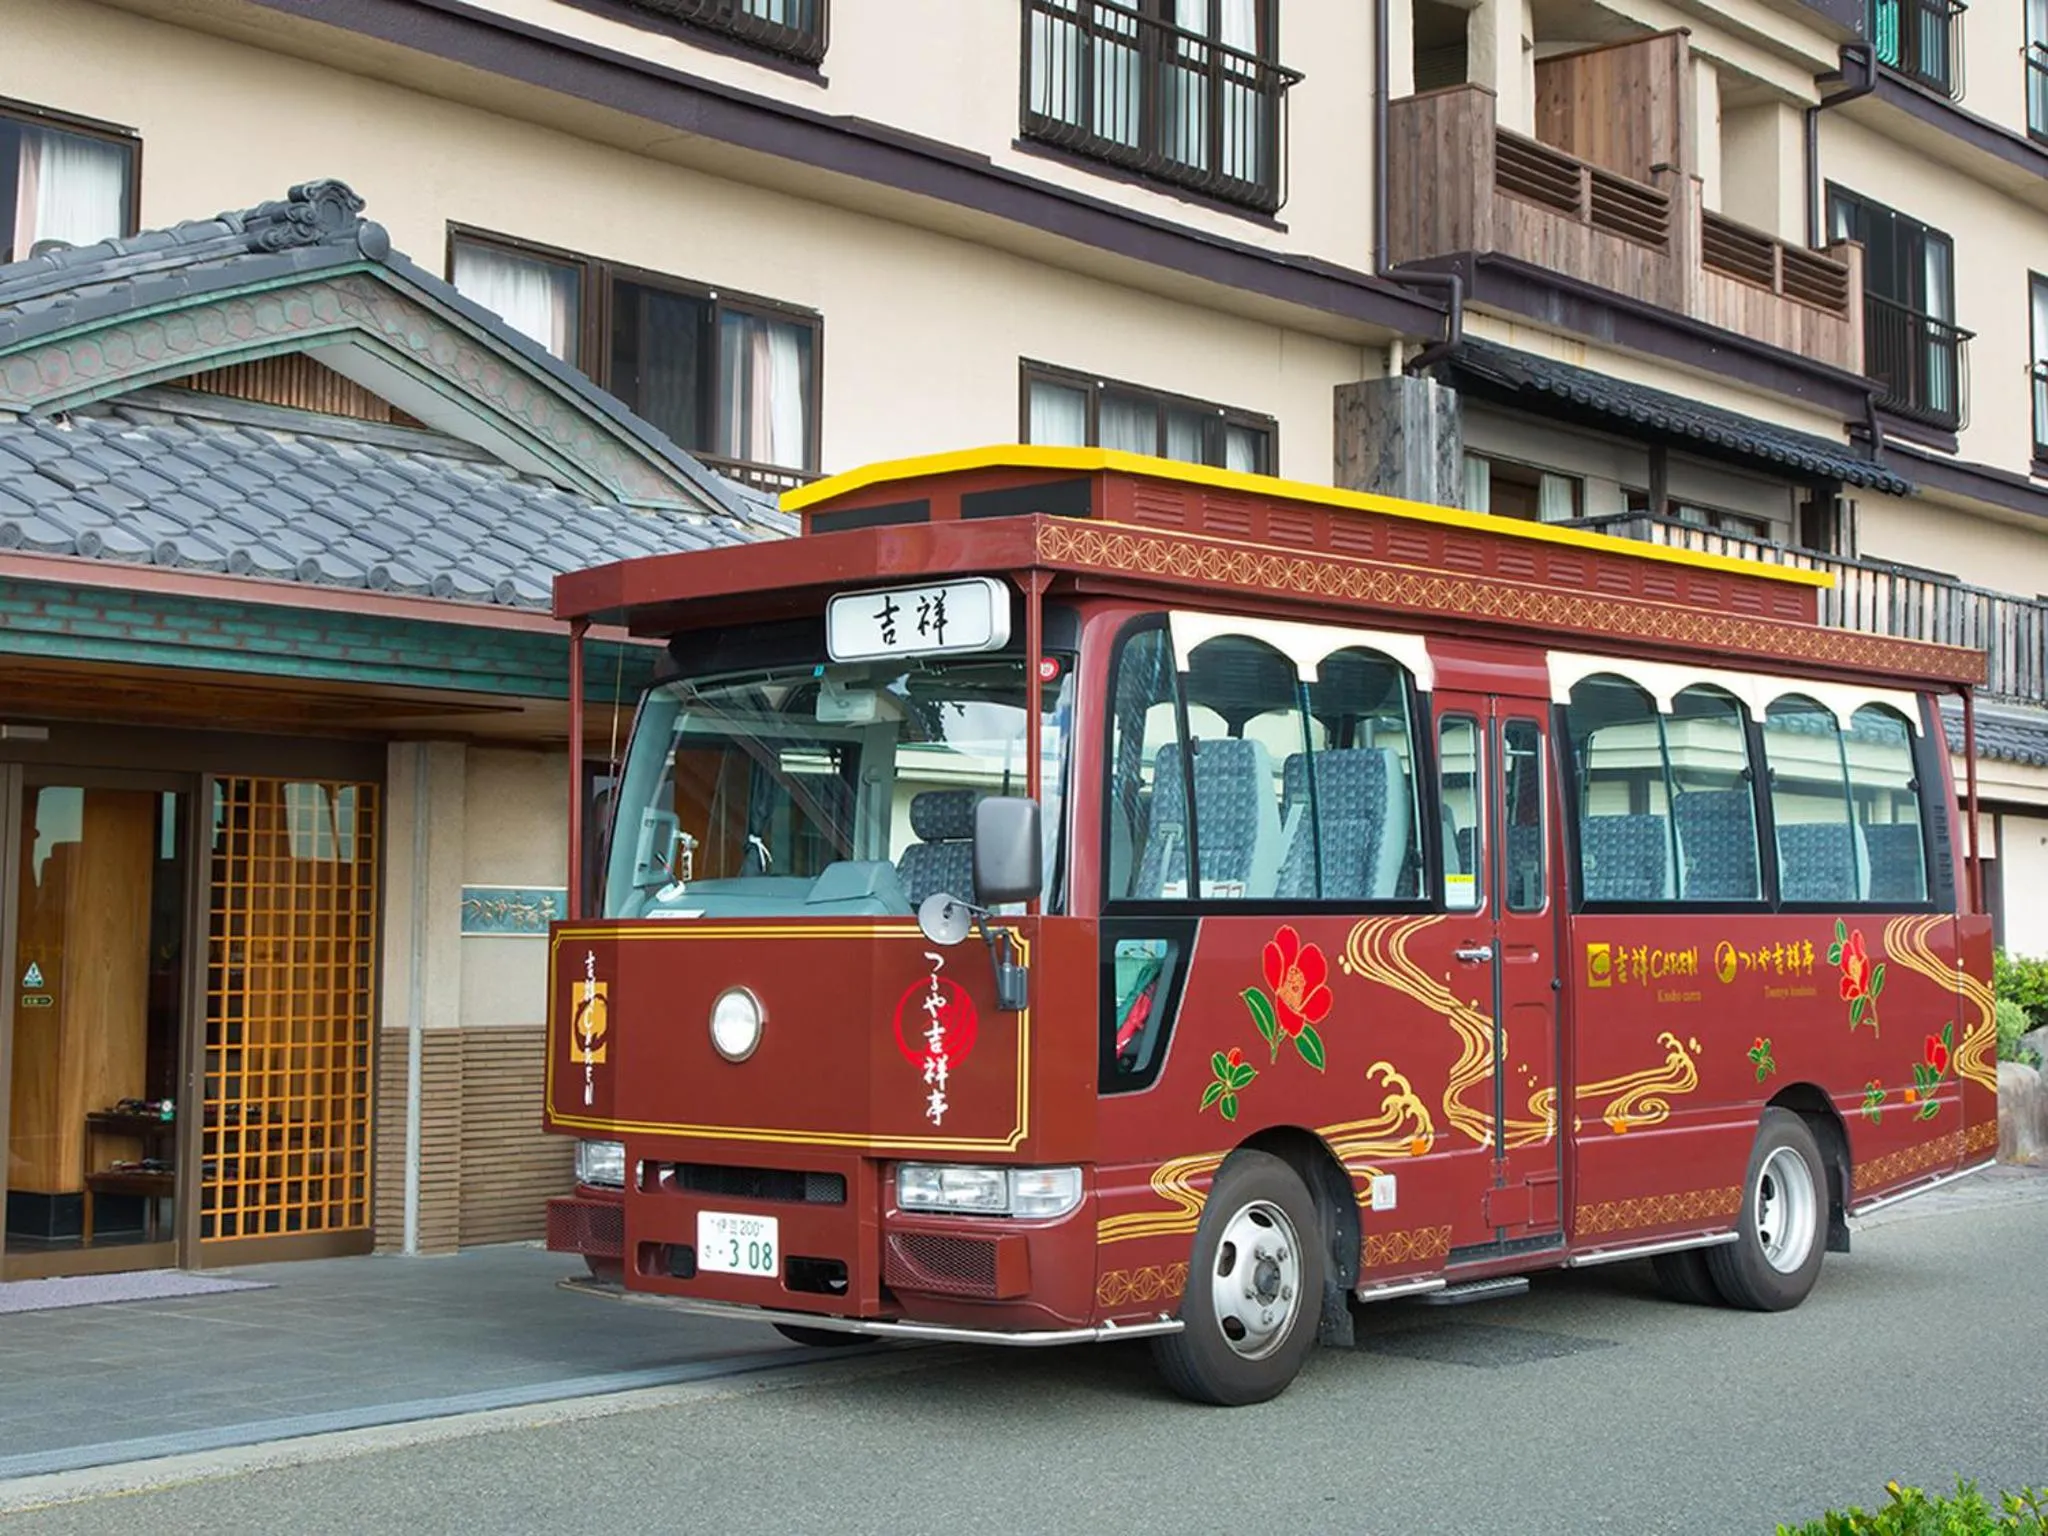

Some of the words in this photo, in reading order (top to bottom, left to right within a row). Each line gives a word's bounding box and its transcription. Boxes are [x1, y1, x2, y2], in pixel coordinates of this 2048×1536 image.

[873, 590, 949, 645] 吉祥
[1739, 938, 1815, 977] つるや吉祥亭
[923, 951, 949, 1126] つるや吉祥亭
